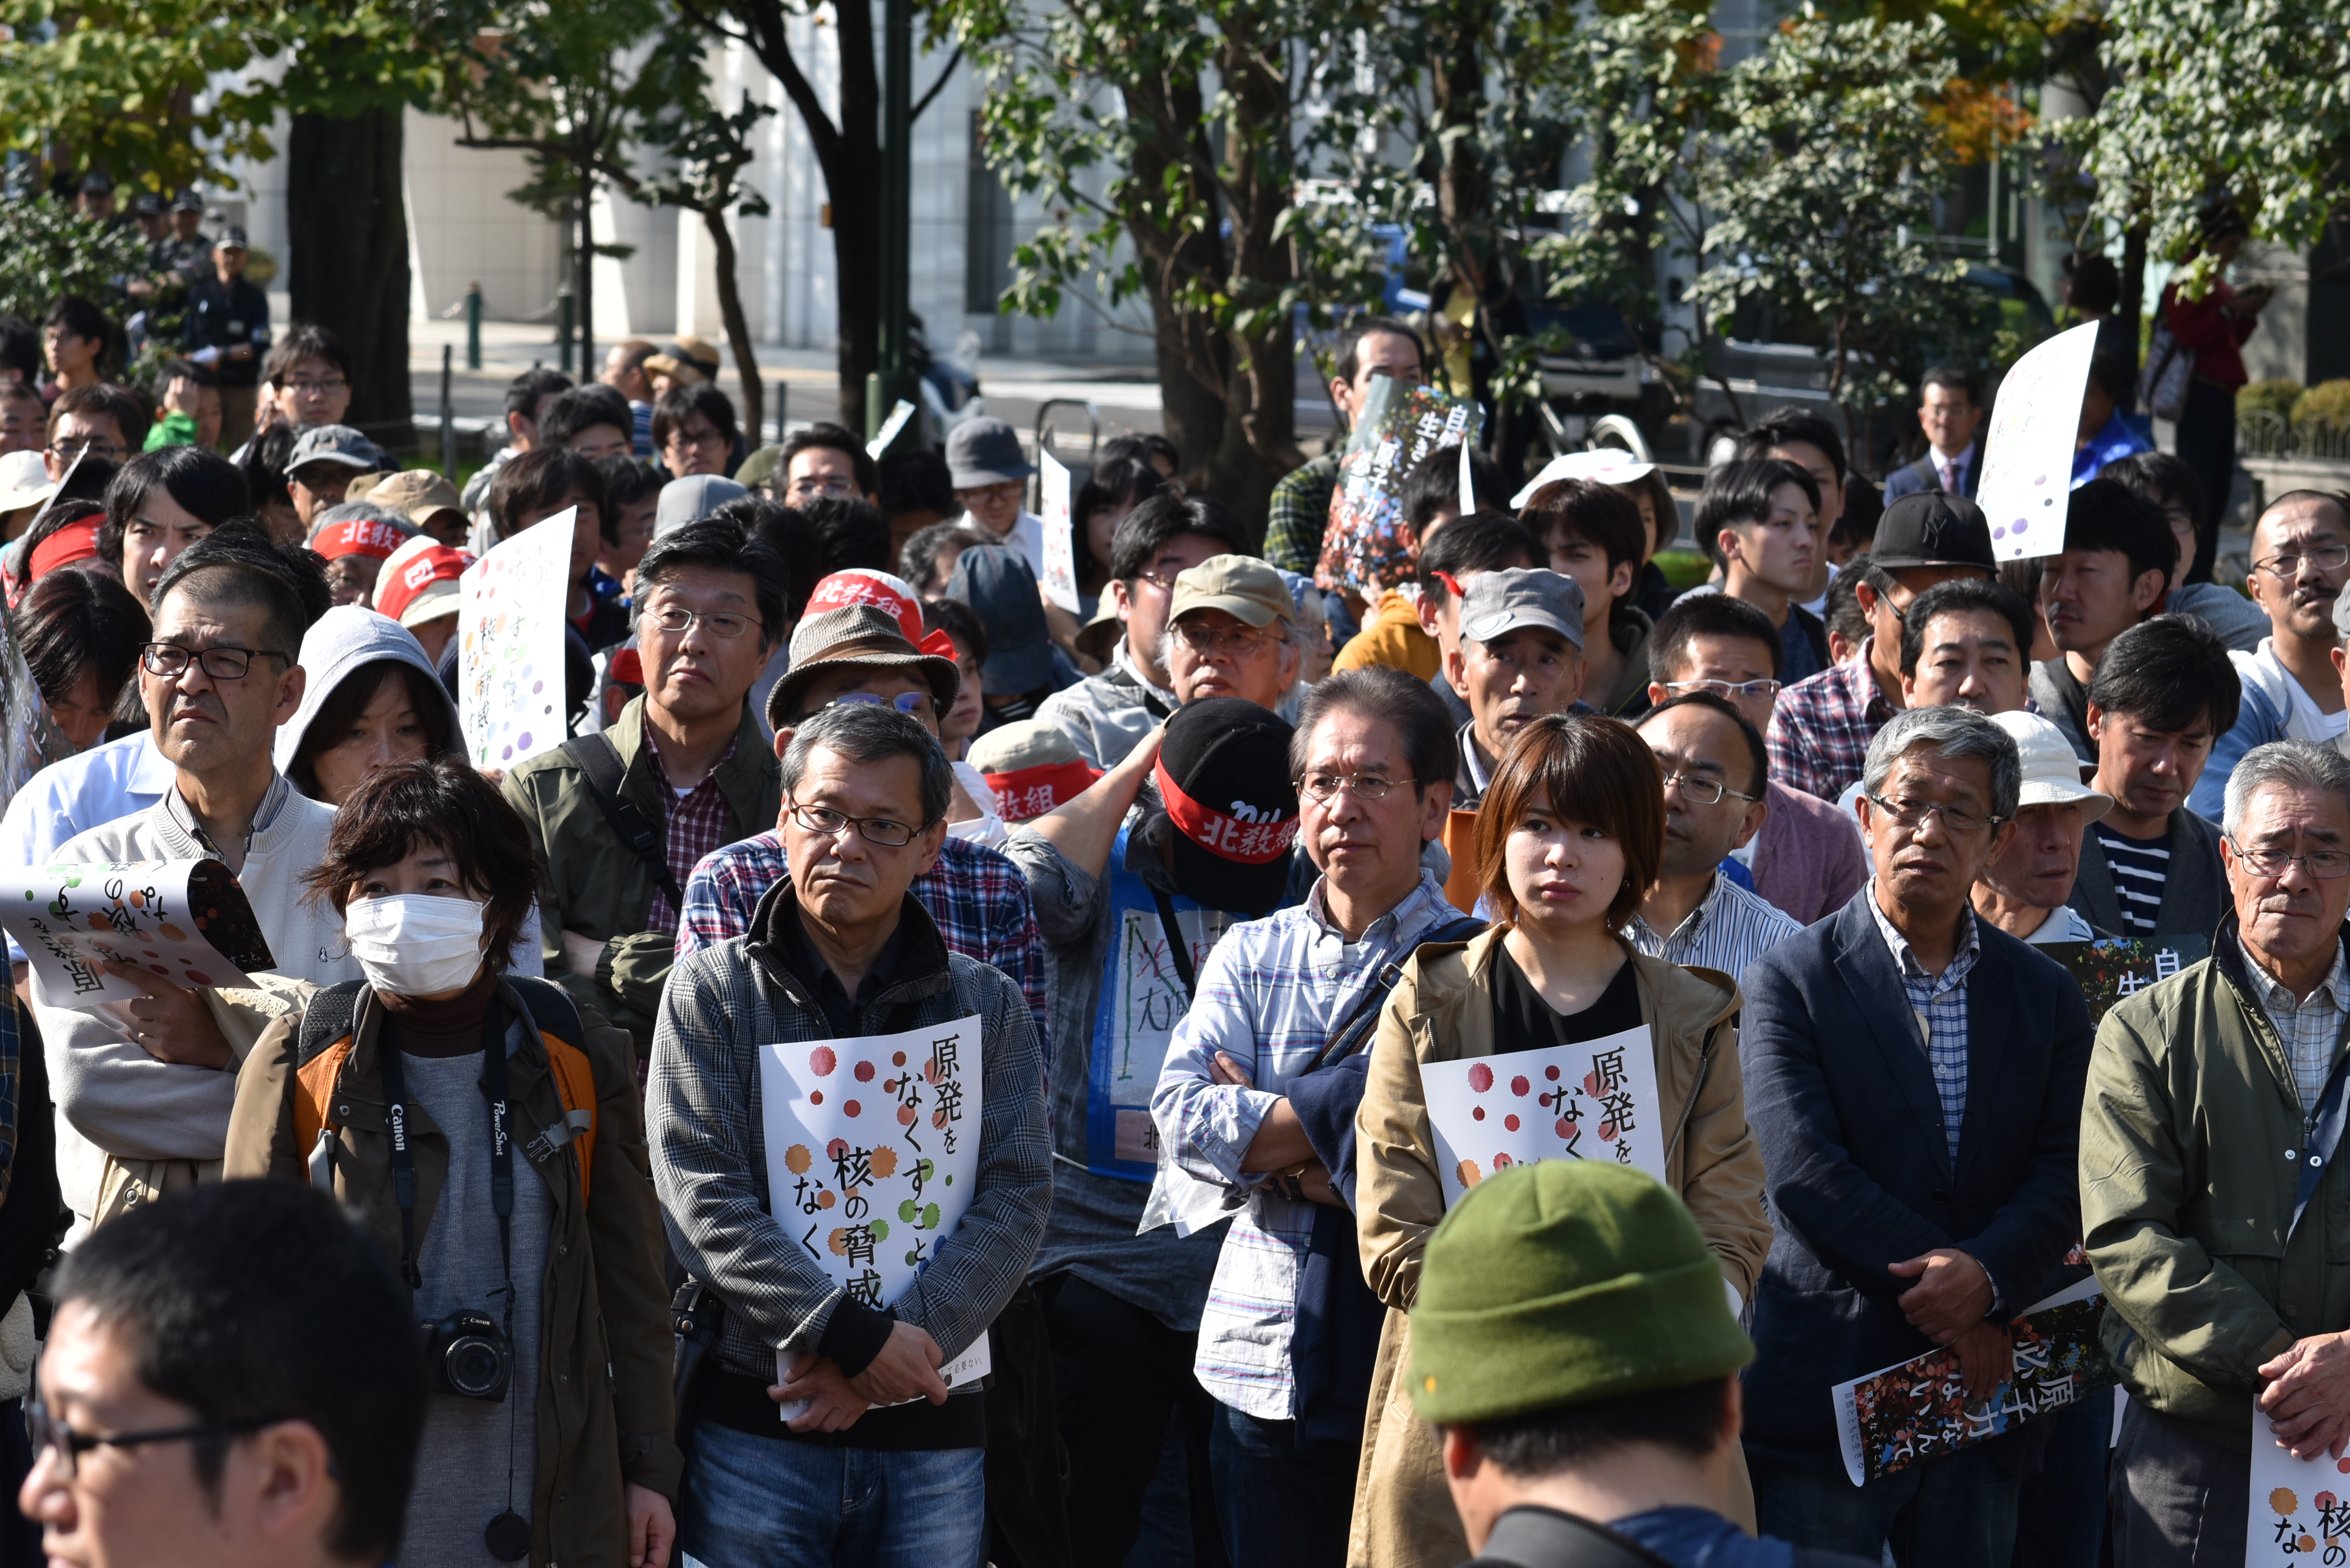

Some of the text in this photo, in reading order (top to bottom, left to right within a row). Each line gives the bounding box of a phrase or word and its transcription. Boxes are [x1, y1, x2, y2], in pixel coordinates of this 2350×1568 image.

[1199, 815, 1299, 856] 北教組
[29, 918, 105, 996] 原発を
[391, 1104, 405, 1151] Canon
[493, 1100, 506, 1156] PowerShot
[932, 1033, 964, 1155] 原発を
[1551, 1086, 1585, 1162] なく
[1593, 1045, 1636, 1165] 原発を
[896, 1071, 931, 1279] なくすこと
[792, 1177, 832, 1279] なく
[832, 1147, 884, 1310] 核の脅威
[470, 1317, 490, 1326] Canon
[1909, 1341, 2049, 1416] 必ない
[1844, 1392, 1864, 1478] 自然とともに生きる
[1894, 1375, 2074, 1460] 原子力なんて
[2274, 1517, 2306, 1568] な
[2317, 1499, 2350, 1567] 核の
